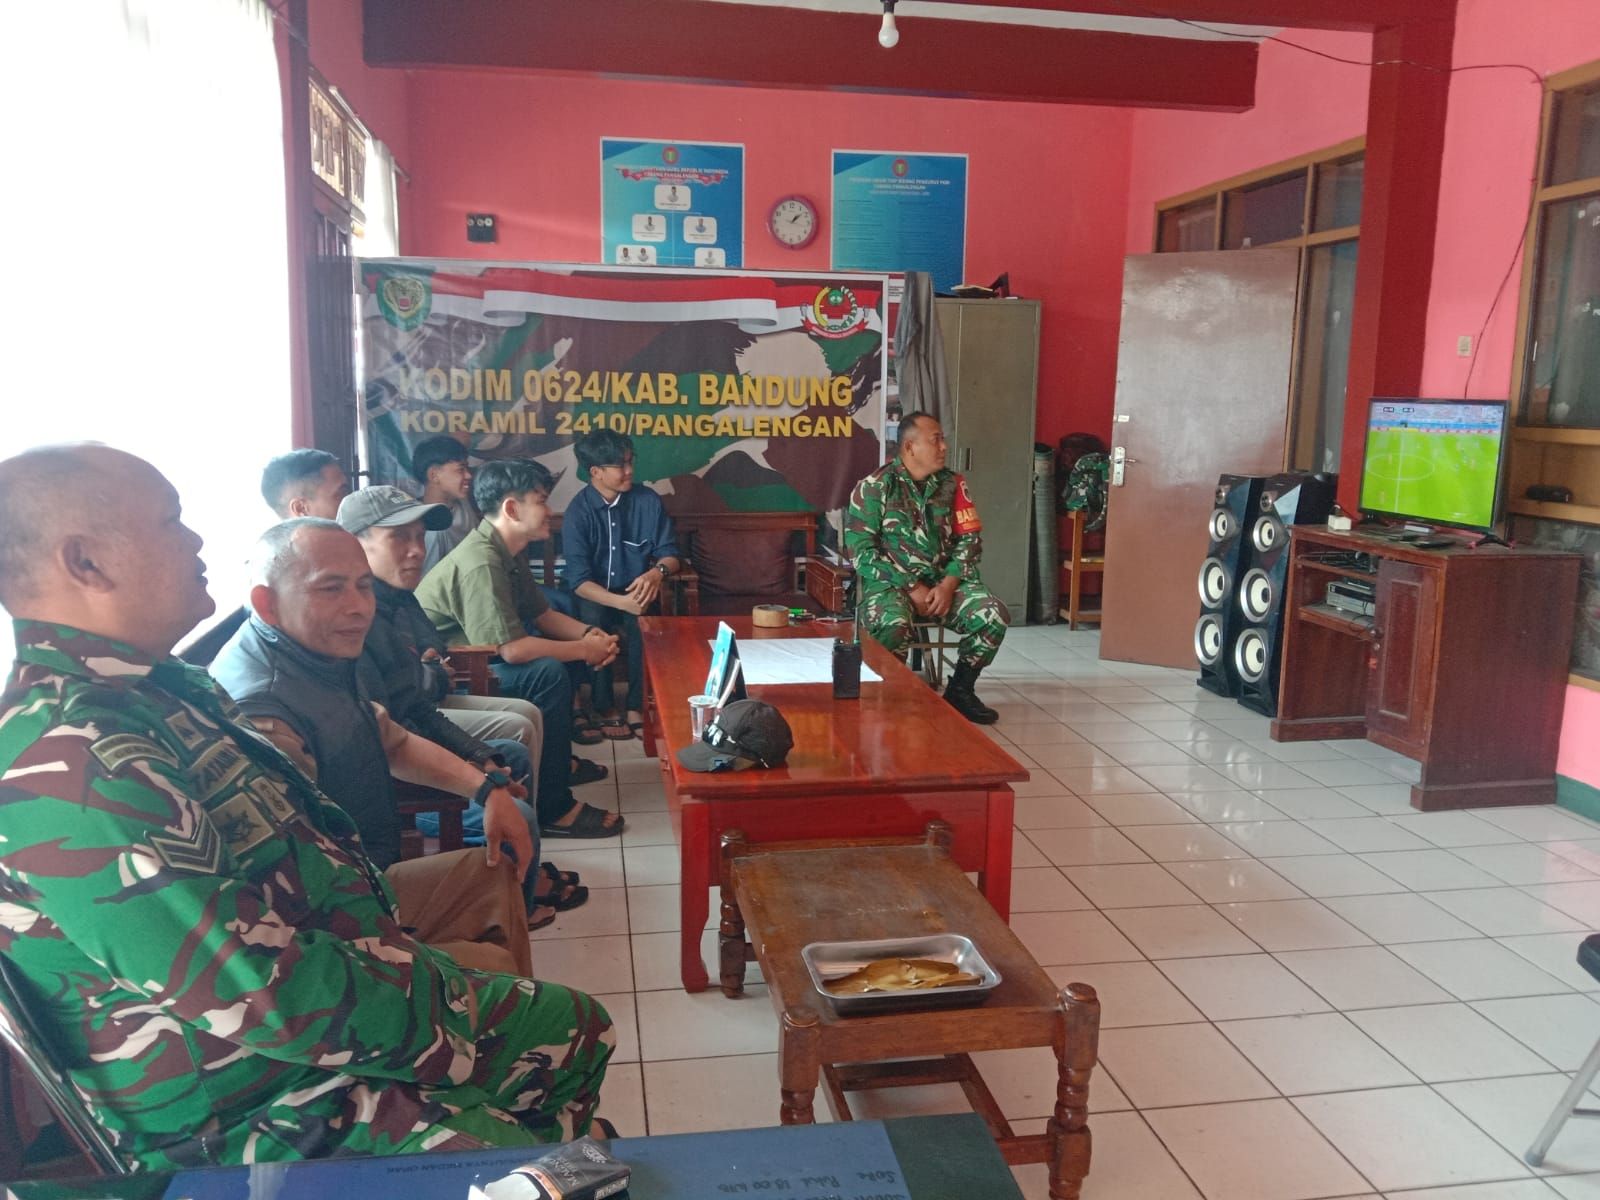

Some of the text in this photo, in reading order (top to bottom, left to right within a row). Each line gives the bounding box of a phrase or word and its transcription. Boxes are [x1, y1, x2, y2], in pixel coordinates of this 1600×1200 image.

[400, 367, 853, 407] KODIM 0624/KAB. BANDUNG
[400, 410, 853, 438] KORAMIL 2410/PANGALENGAN
